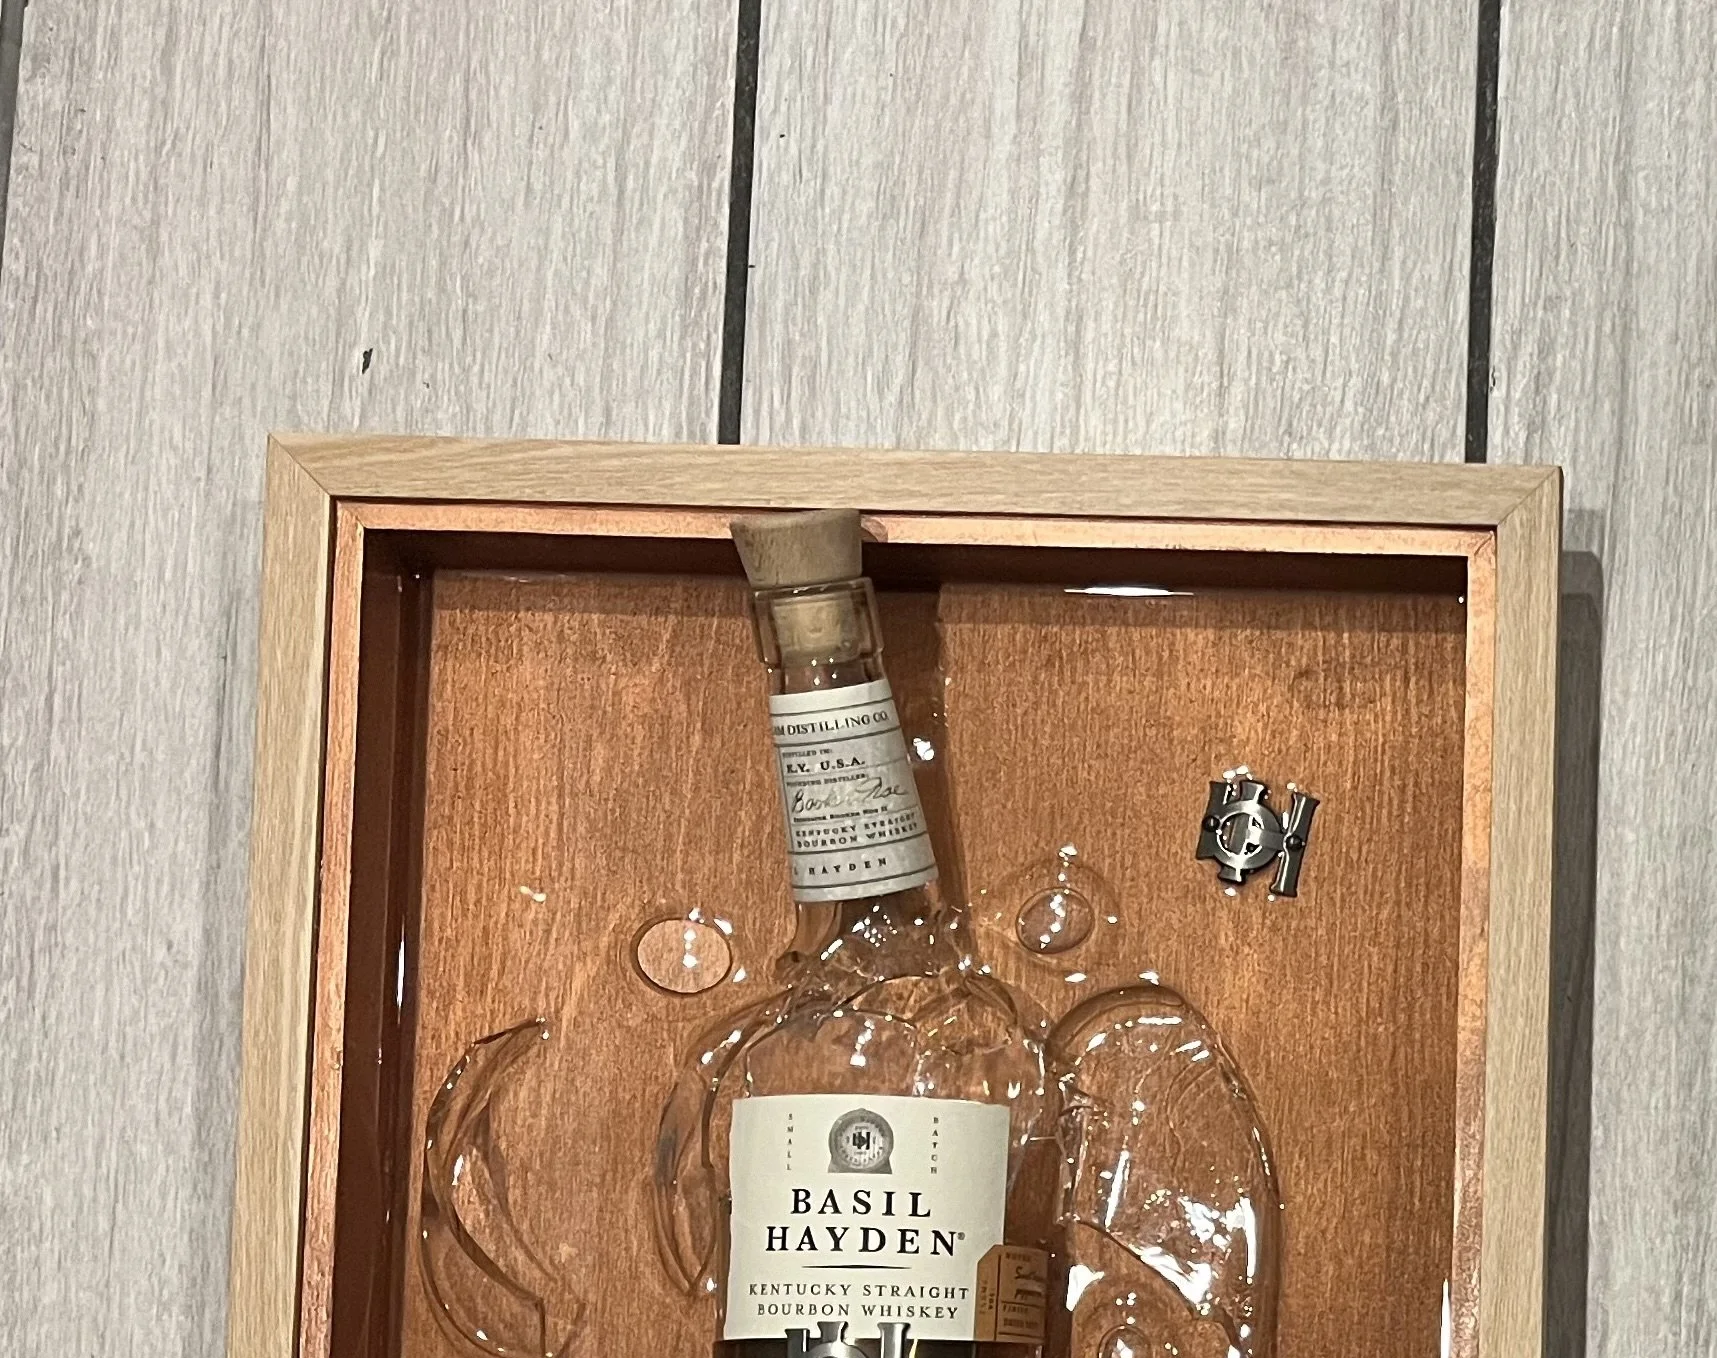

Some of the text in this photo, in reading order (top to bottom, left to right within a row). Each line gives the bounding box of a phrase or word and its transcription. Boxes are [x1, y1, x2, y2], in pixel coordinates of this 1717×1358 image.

[787, 714, 871, 736] DISTILLING
[820, 756, 866, 771] U.S.A.
[795, 824, 857, 838] KENTUCKY
[796, 835, 858, 849] BOURBON
[808, 857, 888, 876] HAYDEN
[930, 1116, 939, 1175] BATCH
[790, 1188, 931, 1218] BASIL
[749, 1283, 852, 1297] KENTUCKY
[862, 1284, 970, 1300] STRAIGHT
[757, 1303, 959, 1320] BOURBON WHISKEY
